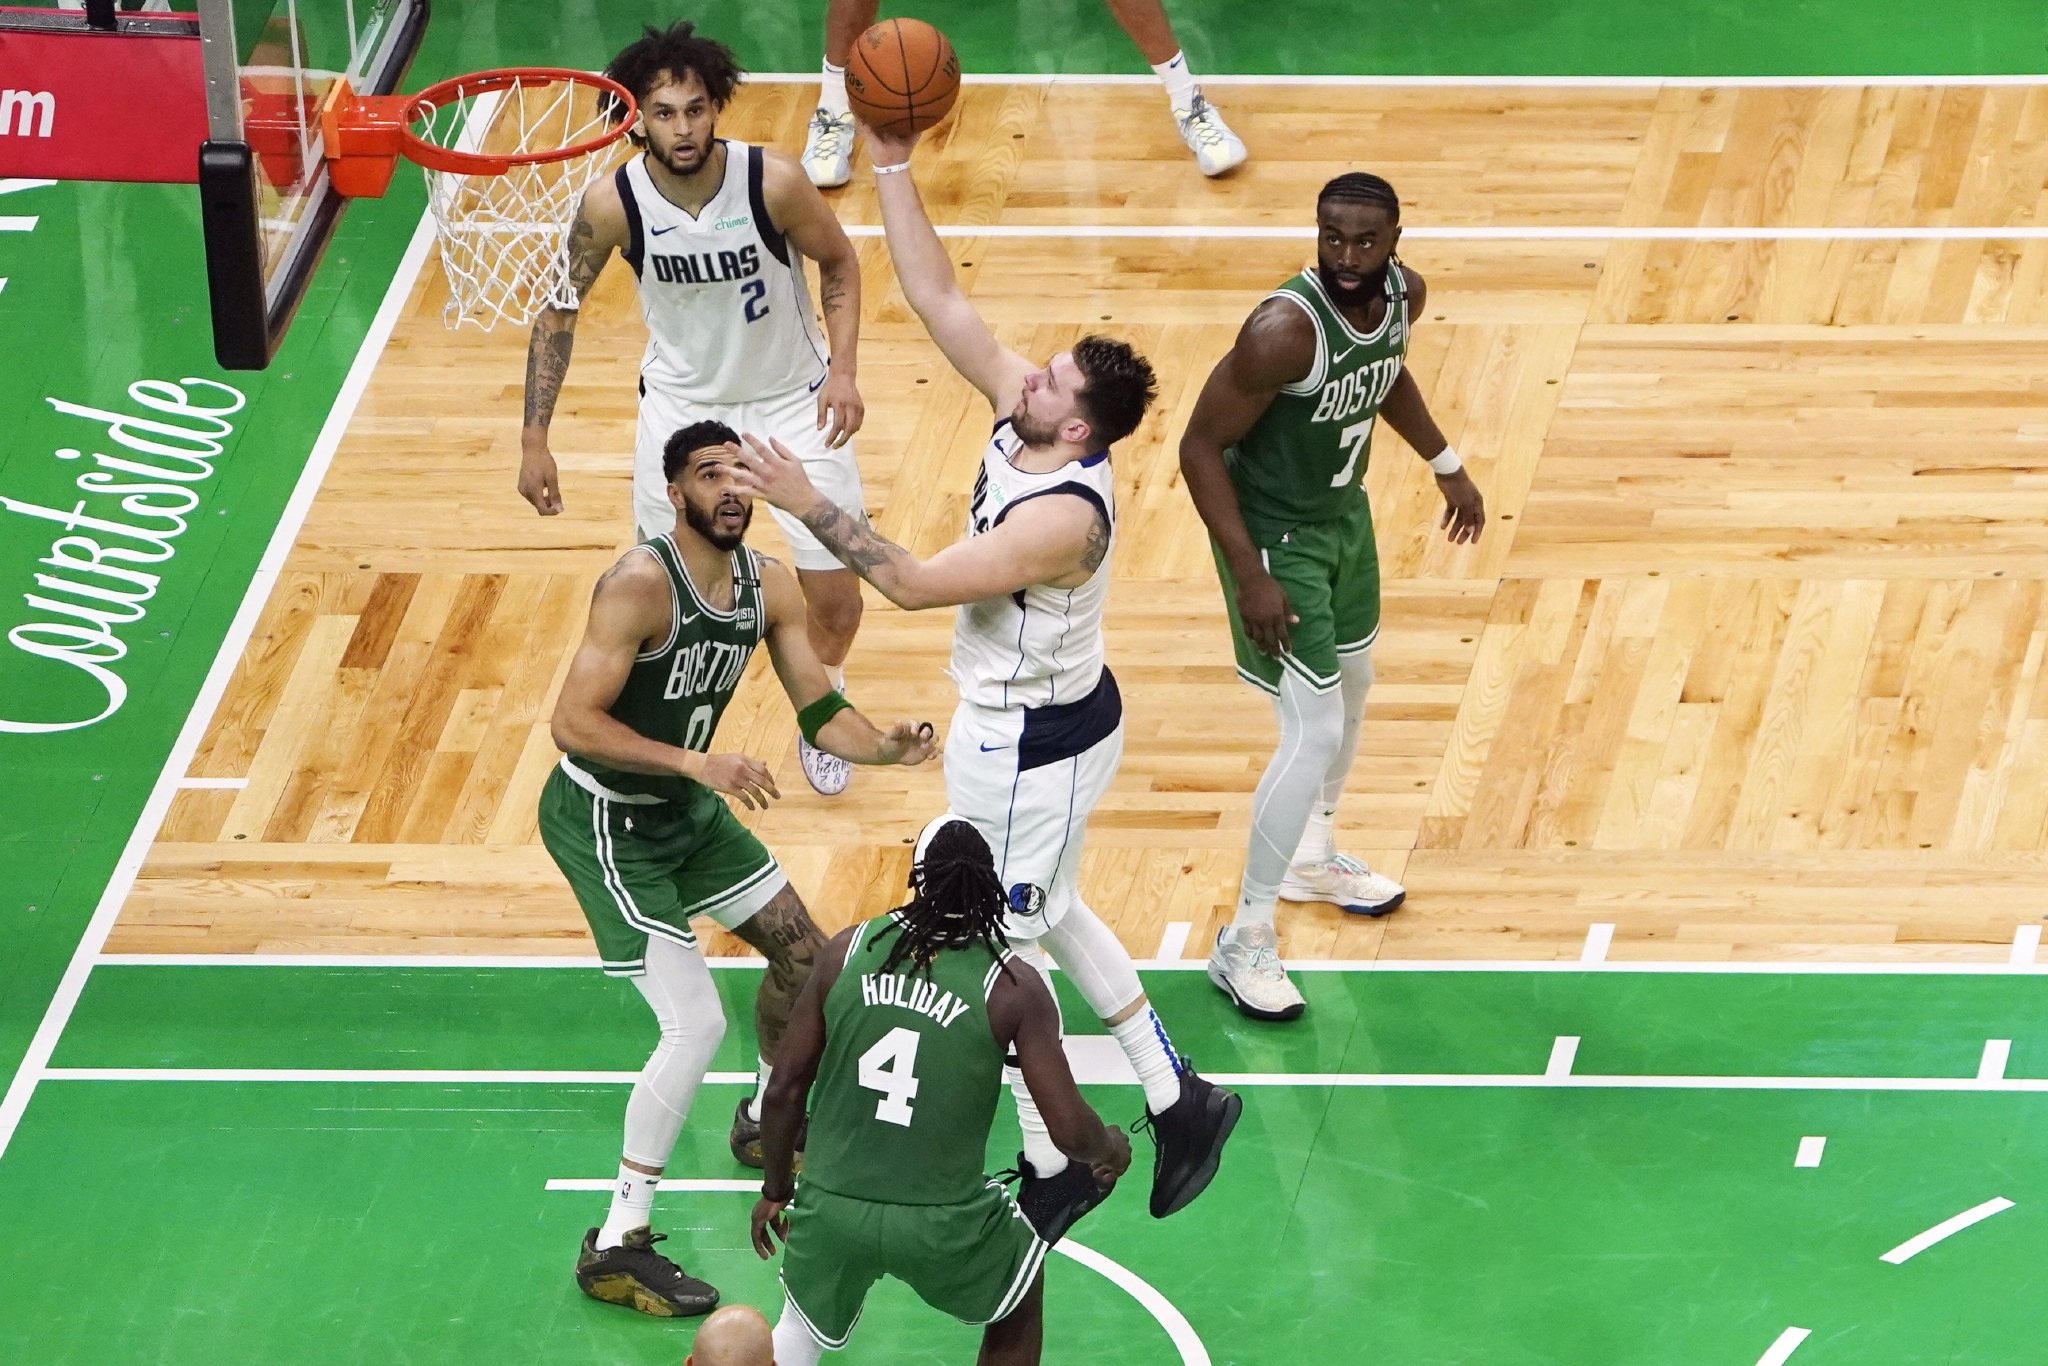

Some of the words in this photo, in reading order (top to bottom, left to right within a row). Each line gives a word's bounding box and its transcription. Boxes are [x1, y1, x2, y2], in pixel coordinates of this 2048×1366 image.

[715, 216, 749, 231] chime
[650, 243, 760, 284] DALLAS
[741, 278, 770, 324] 2
[1311, 353, 1404, 422] BOSTON
[1330, 417, 1374, 488] 7
[735, 619, 756, 631] PRINT
[736, 607, 756, 621] VISTA
[663, 640, 754, 700] BOSTON
[684, 704, 714, 753] 0
[861, 973, 970, 1028] HOLIDAY
[858, 1026, 921, 1127] 4
